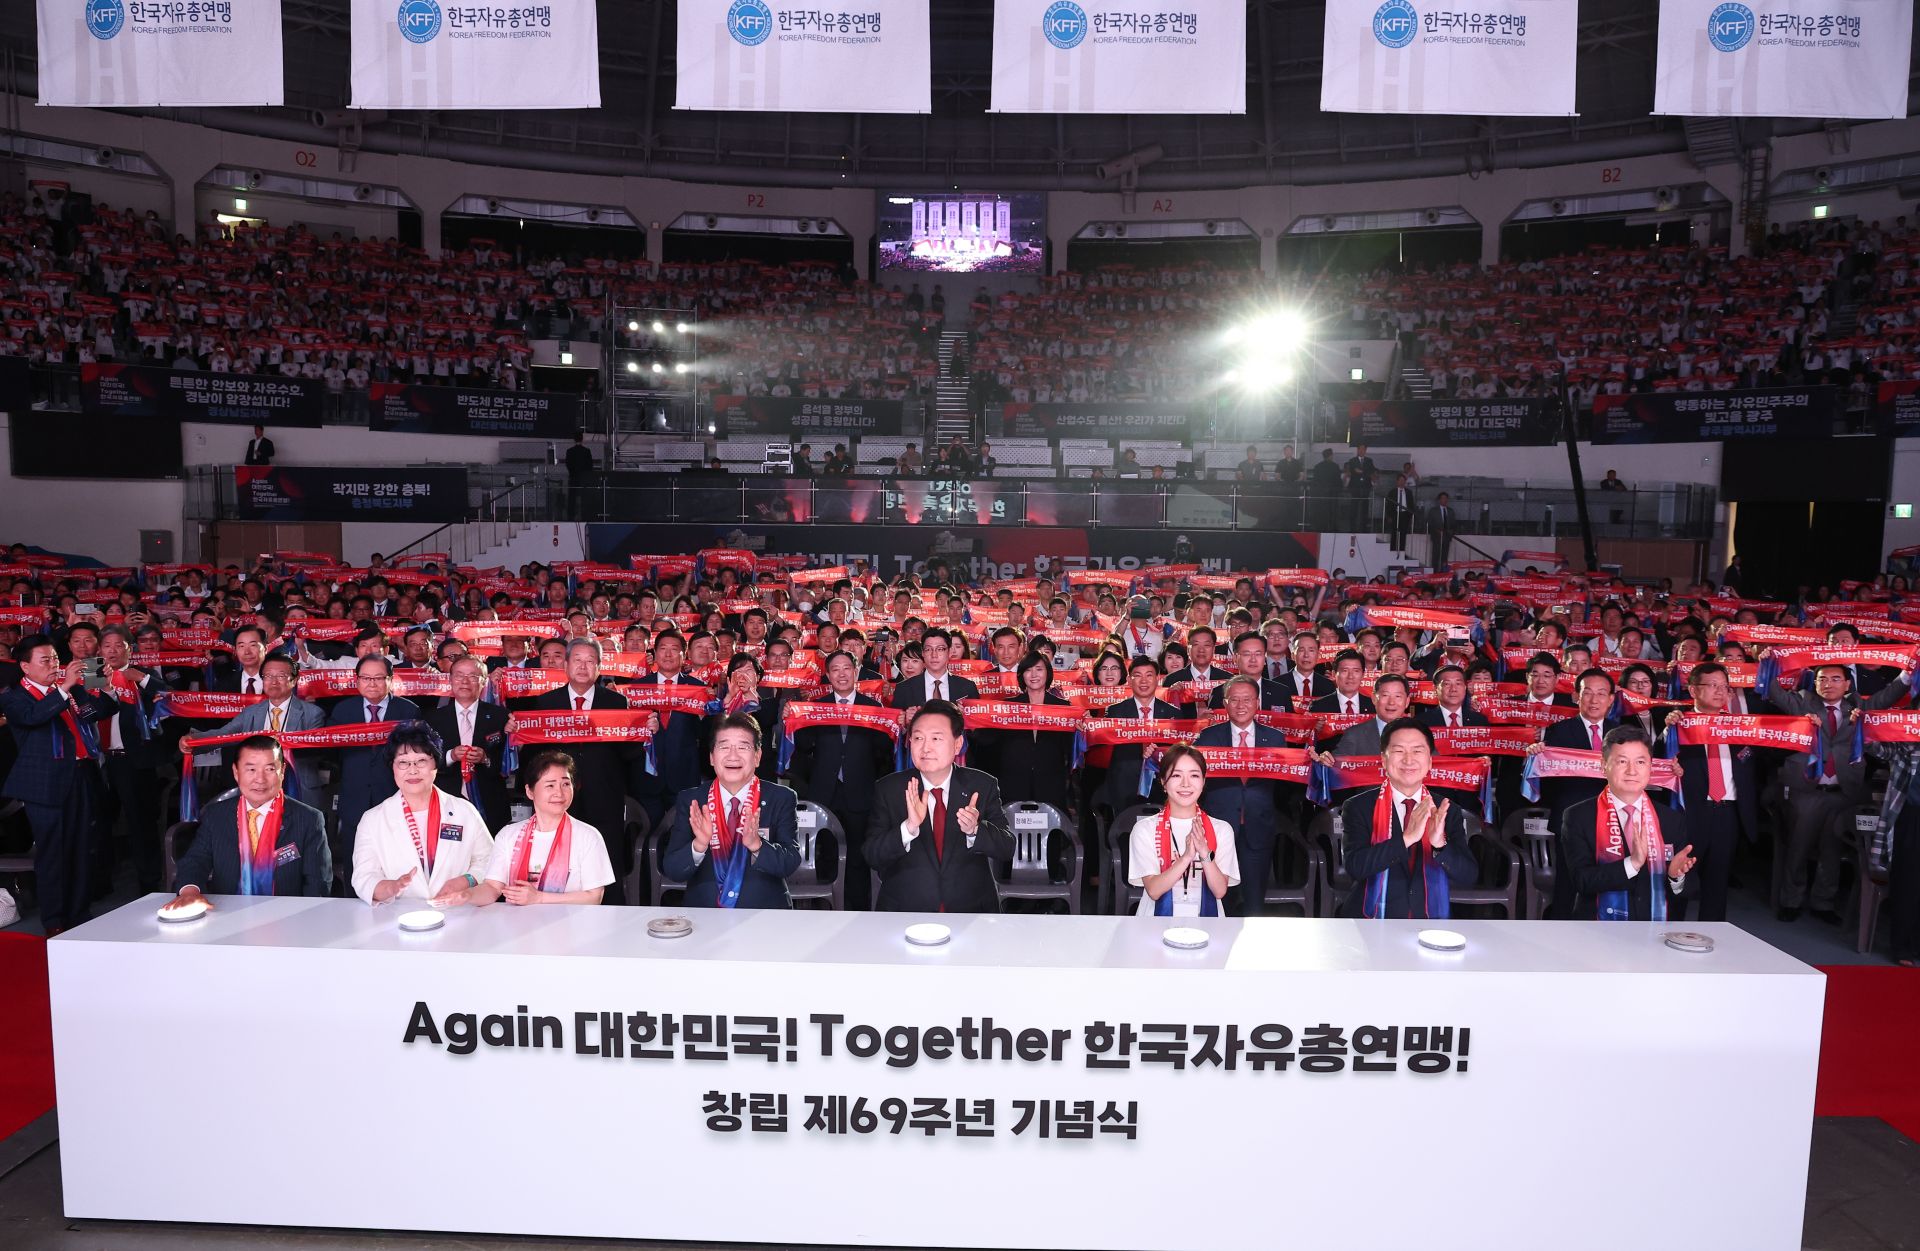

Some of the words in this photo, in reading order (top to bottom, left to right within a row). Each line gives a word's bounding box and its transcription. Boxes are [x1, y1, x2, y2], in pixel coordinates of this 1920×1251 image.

[92, 10, 116, 23] KFF
[130, 1, 231, 23] 한국자유총연맹
[447, 6, 550, 28] 한국자유총연맹
[406, 13, 434, 26] KFF
[735, 15, 764, 30] KFF
[778, 10, 881, 34] 한국자유총연맹
[1094, 12, 1197, 34] 한국자유총연맹
[1381, 18, 1410, 31] KFF
[1424, 12, 1526, 36] 한국자유총연맹
[159, 26, 187, 34] FREEDOM
[1051, 19, 1079, 33] KFF
[1715, 21, 1746, 35] KFF
[1760, 14, 1861, 37] 한국자유총연맹
[474, 31, 507, 39] FREEDOM
[509, 30, 551, 38] FEDERATION
[803, 34, 836, 43] FREEDOM
[838, 36, 881, 44] FEDERATION
[1094, 36, 1117, 44] KOREA
[1119, 36, 1153, 44] FREEDOM
[1154, 36, 1196, 44] FEDERATION
[1484, 38, 1525, 46] FEDERATION
[1785, 38, 1815, 47] FREEDOM
[1818, 40, 1860, 48] FEDERATION
[1602, 167, 1622, 183] B2
[747, 194, 765, 208] P2
[1153, 199, 1173, 213] A2
[170, 376, 207, 389] 튼튼한
[212, 380, 249, 391] 안보와
[185, 392, 222, 404] 경남이
[457, 394, 490, 406] 반도체
[1674, 398, 1726, 411] 행동하는
[1729, 394, 1809, 408] 자유민주주의
[468, 408, 509, 420] 선도도시
[513, 410, 537, 420] 대전!
[802, 404, 831, 414] 윤석열
[834, 405, 862, 415] 정부의
[1430, 406, 1461, 417] 생명의
[1465, 406, 1476, 416] 땅
[1057, 415, 1095, 425] 산업수도
[1125, 415, 1154, 425] 우리가
[1747, 410, 1773, 421] 광주
[1436, 419, 1480, 429] 행복시대
[1483, 418, 1521, 428] 대도약!
[333, 484, 369, 495] 작지만
[373, 484, 398, 495] 강한
[402, 484, 430, 495] 충북!
[1367, 608, 1392, 617] Again!
[1394, 610, 1424, 618] 대한민국!
[1393, 618, 1425, 626] Together!
[1856, 618, 1892, 627] 대한민국!
[180, 630, 210, 638] 대한민국!
[477, 626, 515, 634] Together!
[1860, 625, 1891, 634] ogether!
[1750, 632, 1787, 640] Together!
[1812, 651, 1861, 660] Together!
[300, 672, 324, 684] gain!
[506, 681, 549, 691] Together!
[1061, 688, 1086, 699] gain!
[1090, 686, 1125, 695] 대한민국!
[171, 694, 200, 703] Again!
[204, 695, 241, 703] 대한민국!
[627, 697, 669, 707] Together!
[964, 704, 990, 714] gain!
[993, 704, 1032, 713] 대한민국!
[803, 712, 852, 721] Together!
[991, 714, 1035, 724] Together!
[1118, 717, 1158, 727] 대한민국!
[1713, 715, 1755, 726] 대한민국!
[1864, 713, 1903, 725] Again!
[515, 718, 541, 730] gain!
[546, 716, 589, 726] 대한민국!
[544, 728, 592, 738] Together!
[1116, 729, 1161, 738] Together!
[1431, 729, 1448, 739] ain!
[1453, 728, 1490, 738] 대한민국!
[1711, 727, 1756, 737] Together!
[1451, 739, 1492, 749] Together!
[1202, 760, 1245, 770] ogether!
[1248, 760, 1310, 775] 한국자유총연맹!
[1605, 808, 1624, 856] Again!
[402, 1001, 562, 1055] Again
[575, 1011, 798, 1063] 대한민국!
[810, 1013, 1072, 1068] Together
[1084, 1021, 1471, 1074] 한국자유총연맹!
[701, 1090, 788, 1133] 창립
[803, 1095, 995, 1138] 제69주년
[1010, 1099, 1138, 1140] 기념식
